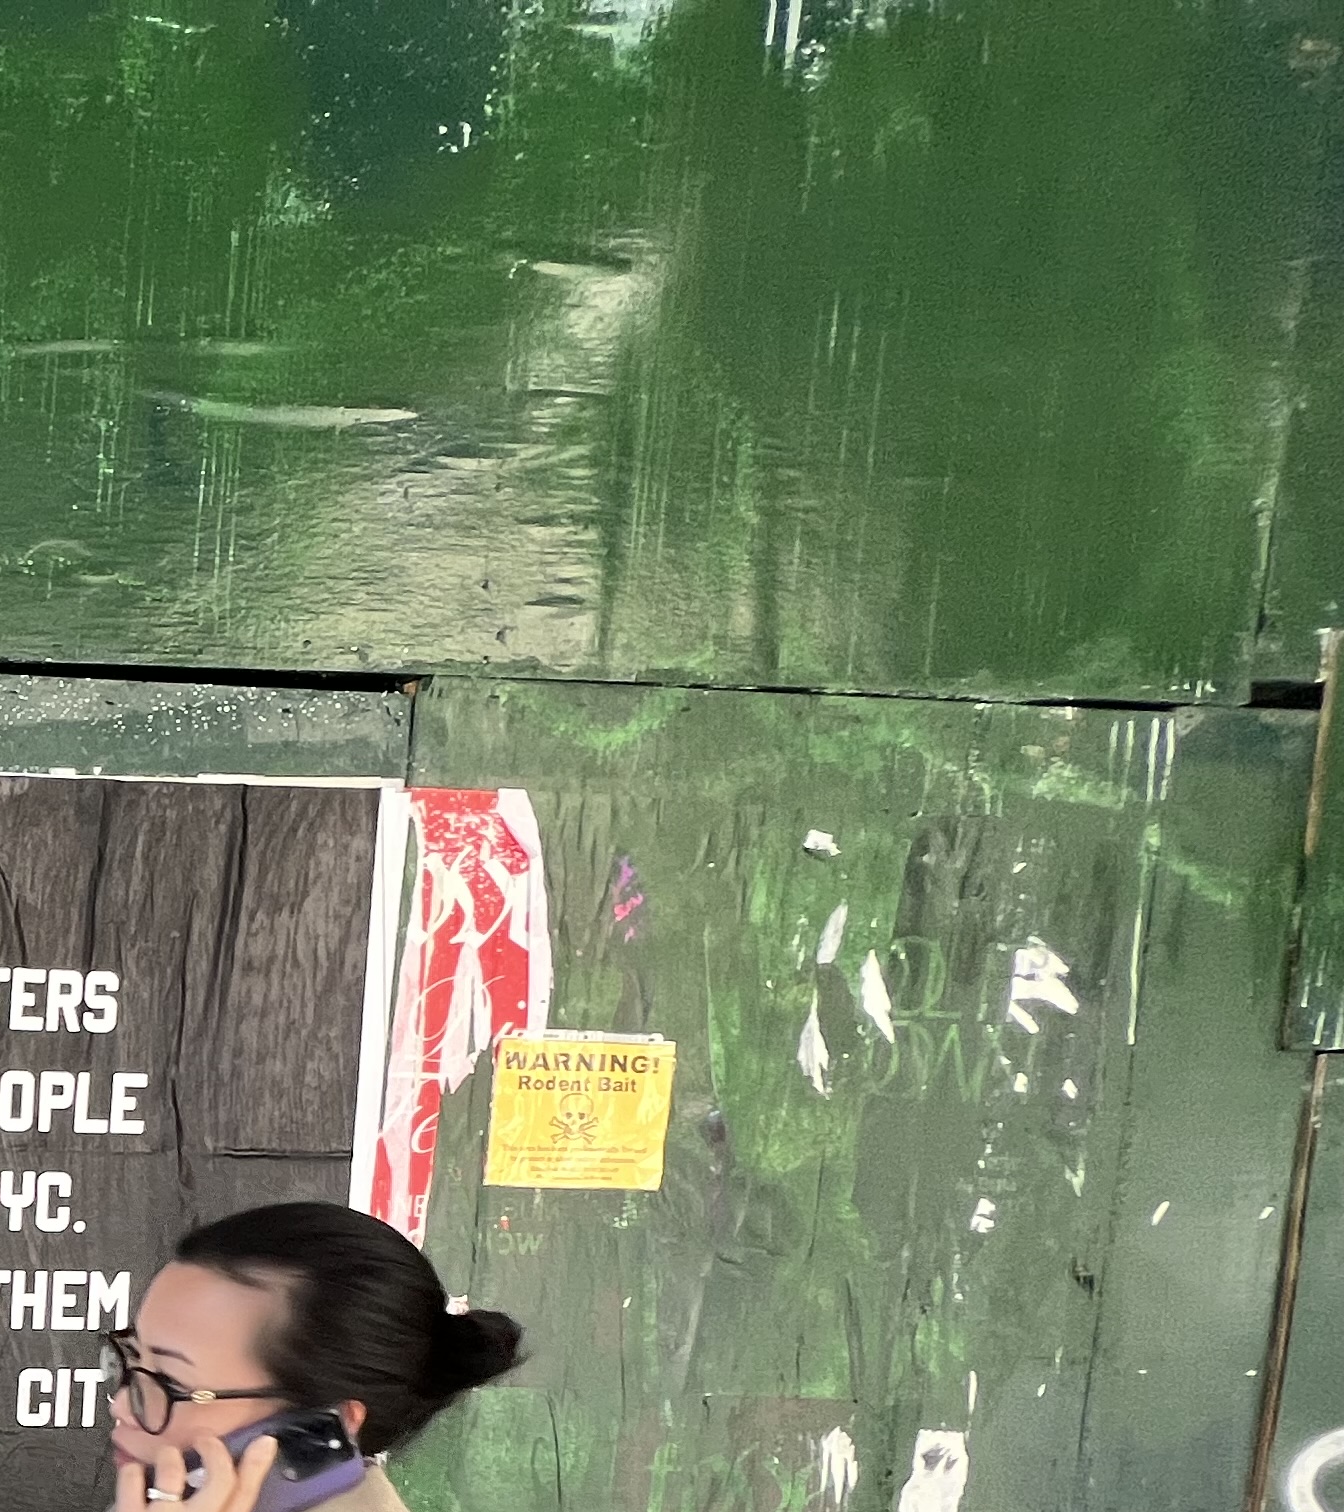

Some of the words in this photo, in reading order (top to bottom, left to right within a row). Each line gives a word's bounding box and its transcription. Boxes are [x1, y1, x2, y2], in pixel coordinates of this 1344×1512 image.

[506, 1051, 660, 1074] WARNING!
[518, 1075, 591, 1092] Rodent
[598, 1077, 637, 1093] Bait
[15, 1367, 115, 1429] CIT
